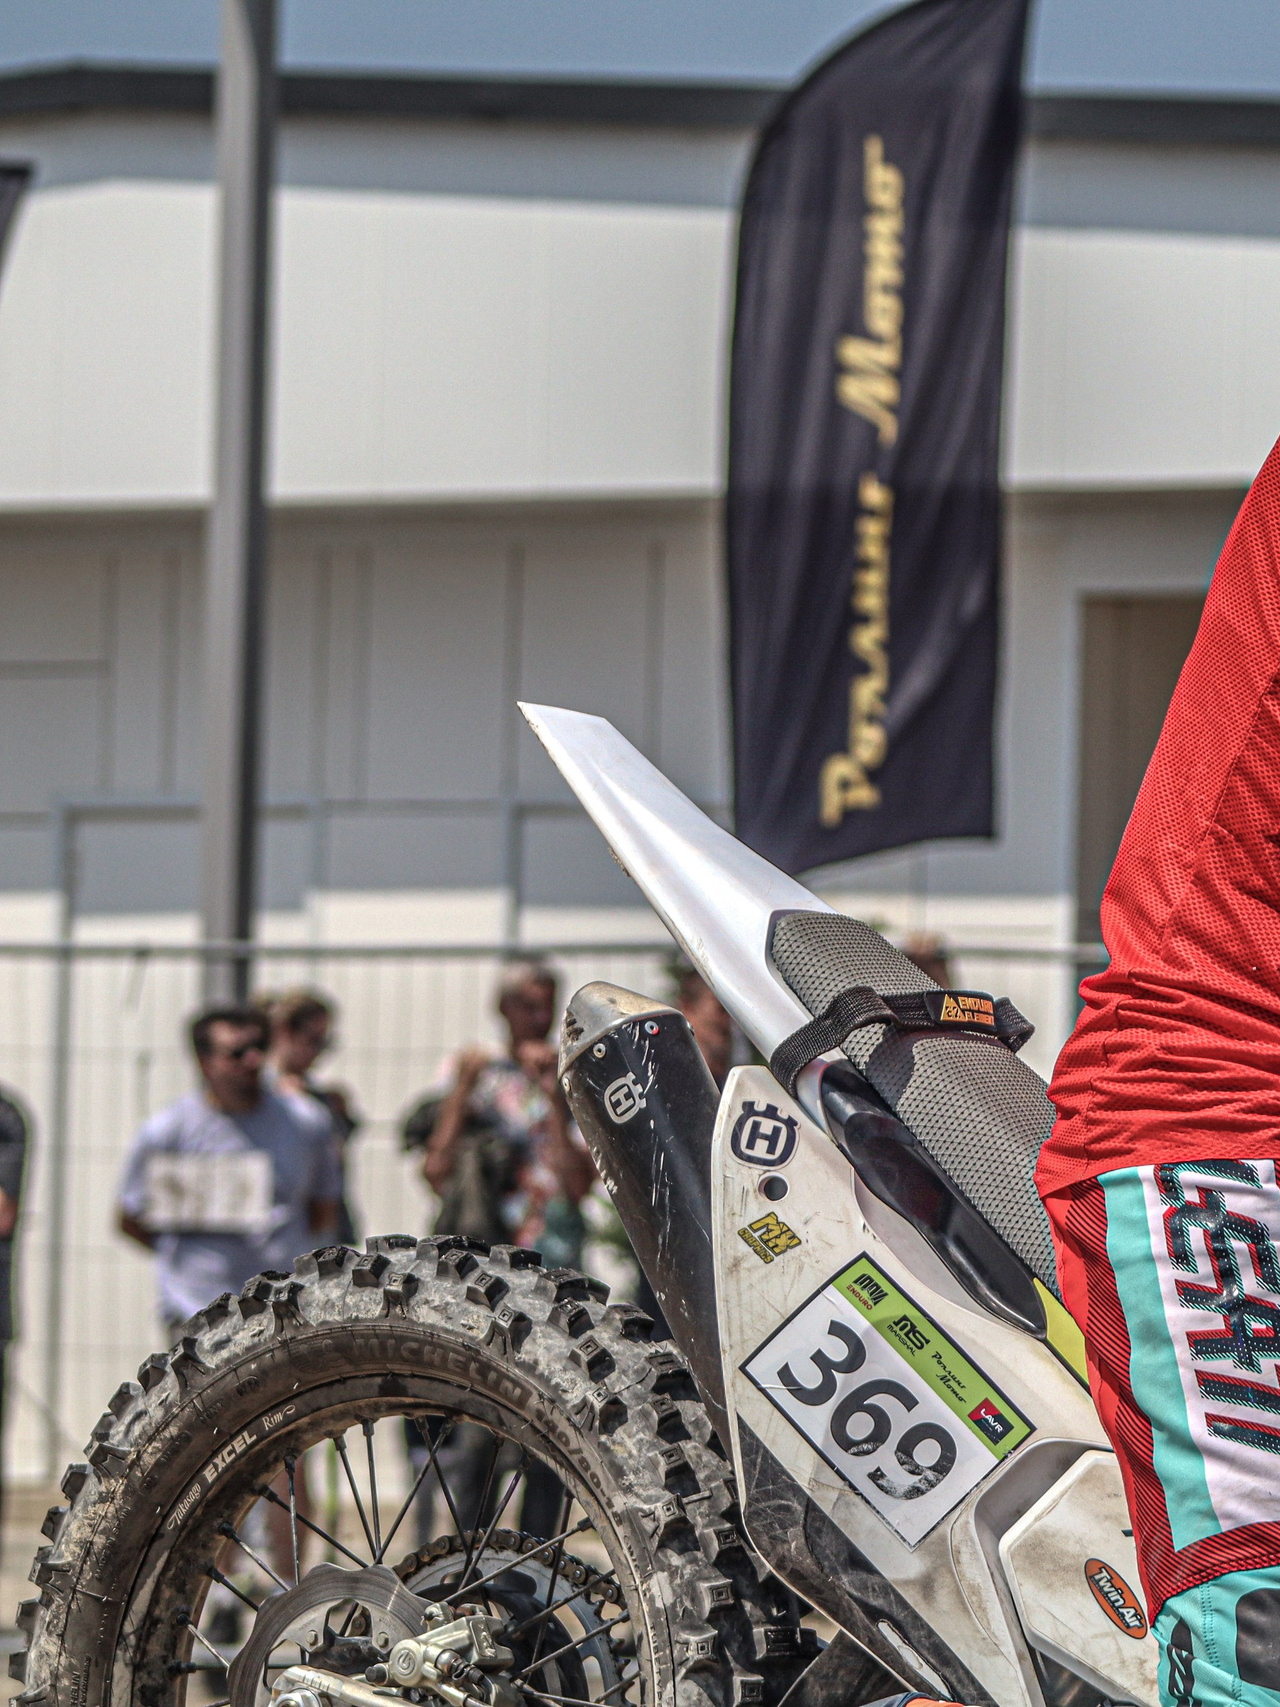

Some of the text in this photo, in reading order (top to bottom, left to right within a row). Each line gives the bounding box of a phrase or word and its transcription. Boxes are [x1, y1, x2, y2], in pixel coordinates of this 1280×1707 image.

[846, 1283, 873, 1311] ENDURO
[354, 1337, 523, 1399] MICHELIN
[886, 1322, 917, 1357] MARSHAL
[776, 1319, 957, 1500] 369
[979, 1408, 1004, 1435] LAVR
[202, 1430, 257, 1483] EXCEL
[262, 1404, 296, 1431] Rim
[1093, 1566, 1124, 1608] Twin
[1117, 1607, 1144, 1628] Air
